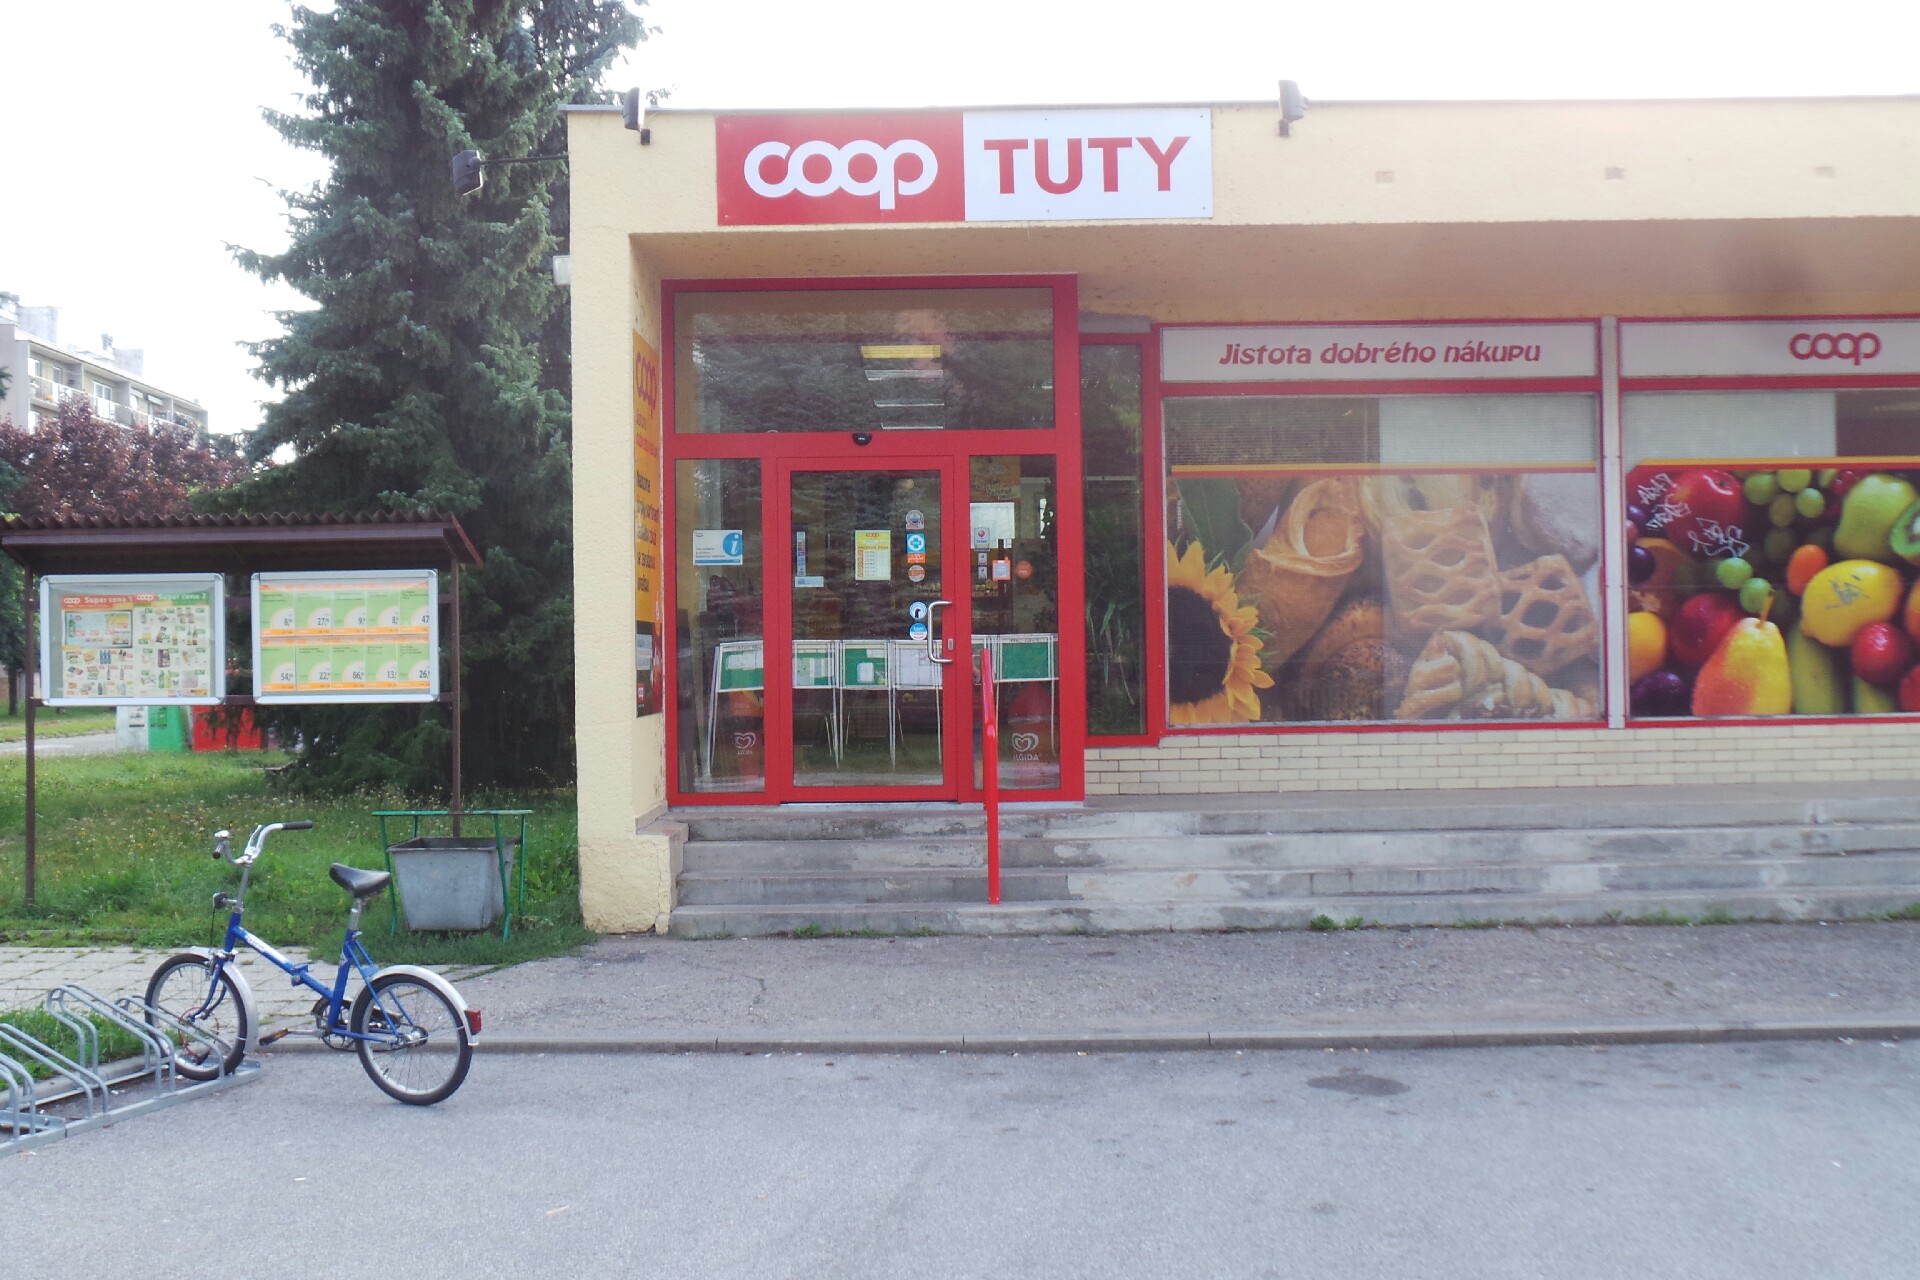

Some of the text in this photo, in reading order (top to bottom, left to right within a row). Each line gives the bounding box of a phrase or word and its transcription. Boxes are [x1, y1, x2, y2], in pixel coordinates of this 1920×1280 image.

[743, 136, 1191, 210] coop TUTY
[1219, 340, 1541, 365] Jistota dobrého nákupu
[1789, 332, 1882, 366] coop
[636, 352, 657, 419] coop
[64, 597, 81, 605] coop
[84, 597, 107, 605] Super
